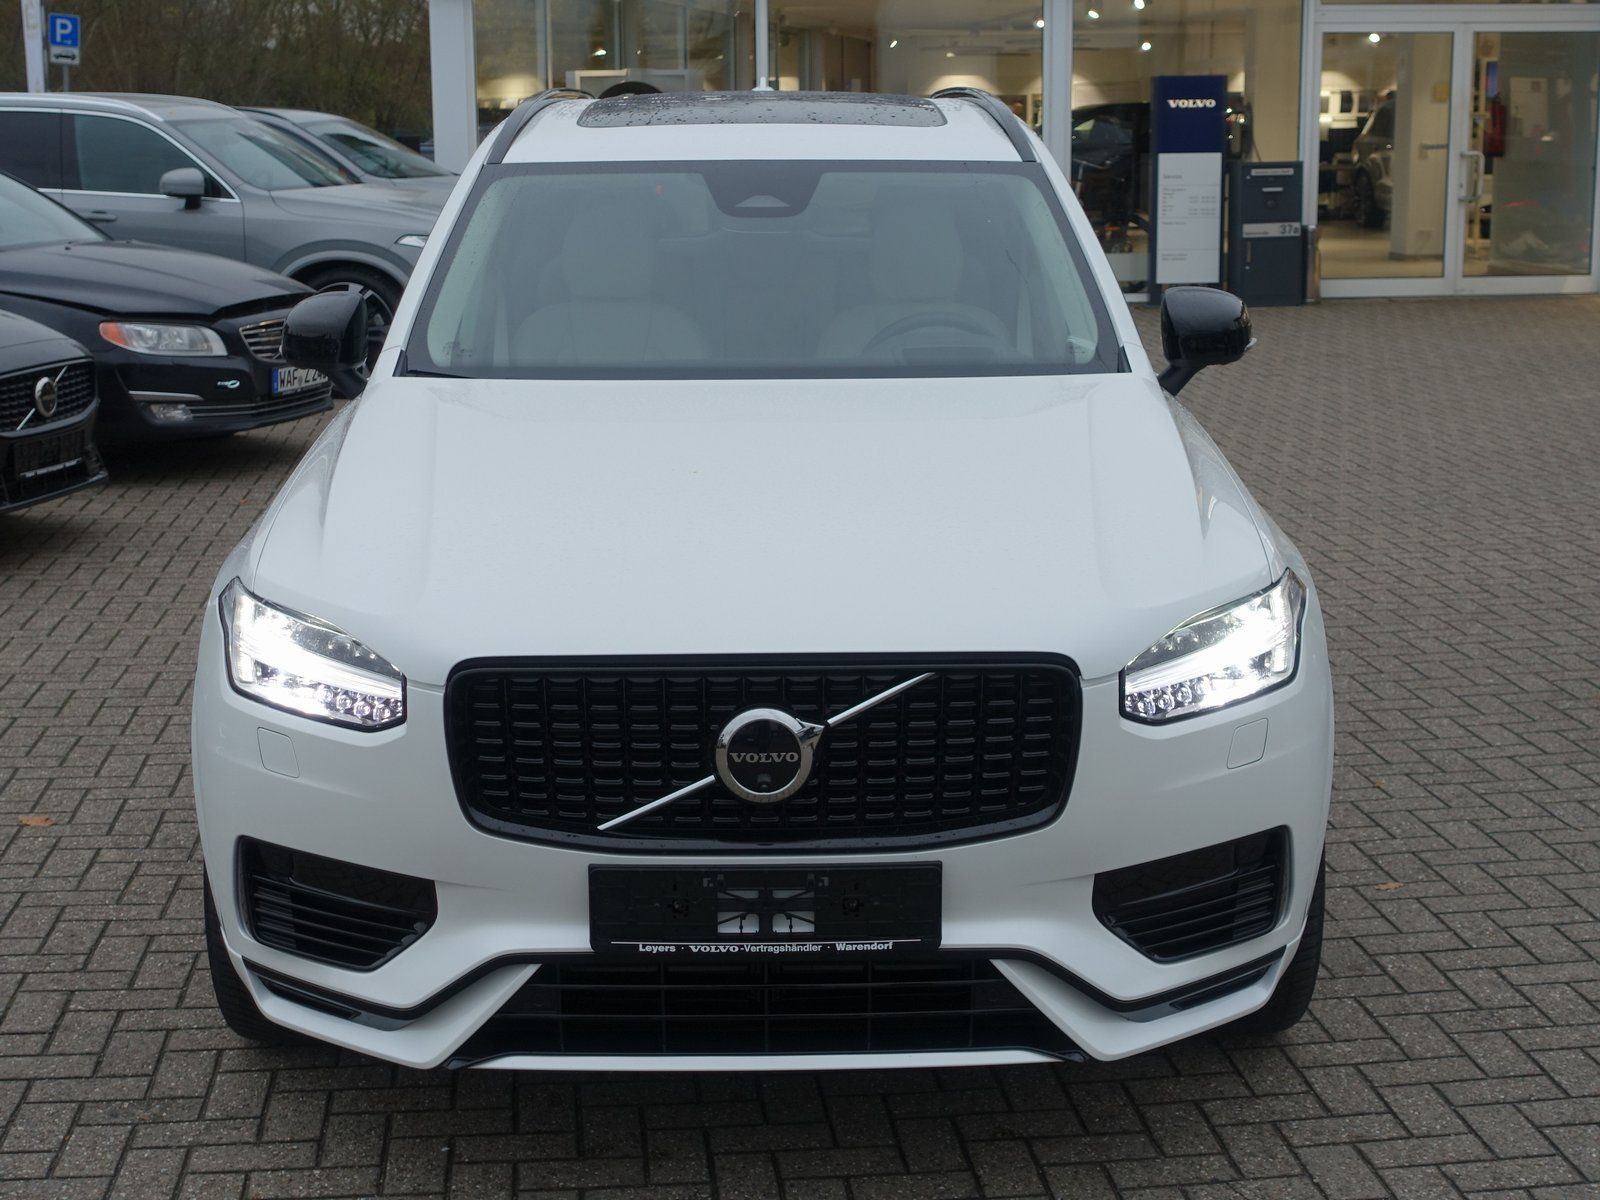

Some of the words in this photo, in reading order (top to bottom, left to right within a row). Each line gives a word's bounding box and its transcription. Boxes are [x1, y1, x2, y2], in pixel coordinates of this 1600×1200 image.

[55, 18, 73, 43] P
[1168, 99, 1216, 108] VOLVO
[729, 752, 799, 763] VOLVO
[639, 943, 676, 953] Leyers
[835, 941, 894, 951] Warendorf
